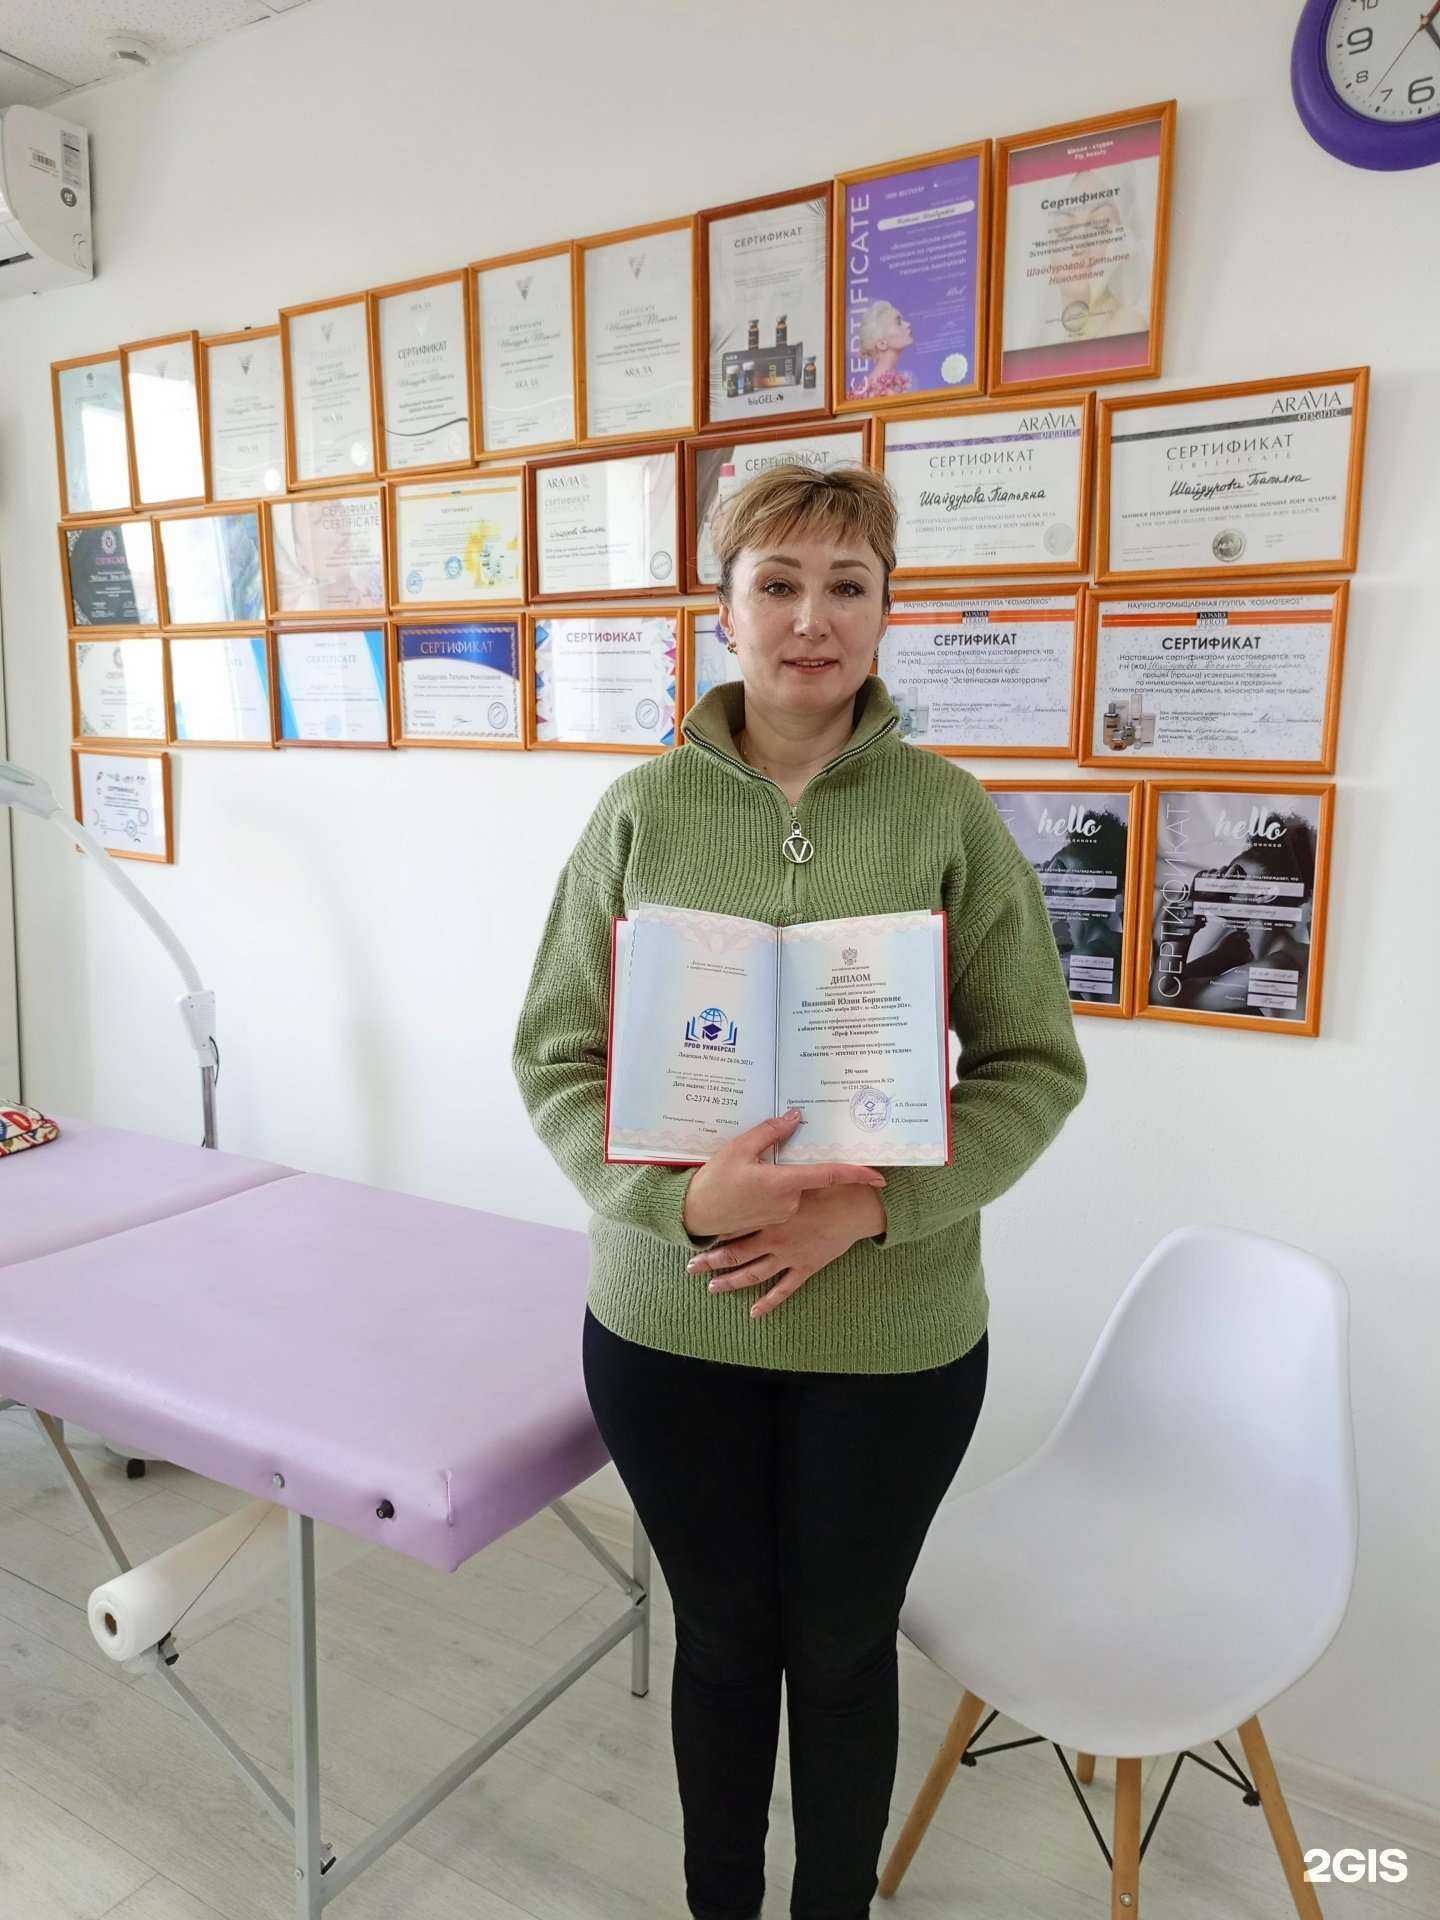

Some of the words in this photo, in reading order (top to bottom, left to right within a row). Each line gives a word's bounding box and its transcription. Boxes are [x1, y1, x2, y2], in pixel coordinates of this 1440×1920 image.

[1347, 27, 1373, 55] 9
[1356, 70, 1369, 84] 8
[1380, 89, 1393, 102] 7
[1407, 76, 1435, 104] 6
[1041, 187, 1120, 210] Сертификат
[733, 226, 803, 249] СЕРТИФИКАТ
[1271, 391, 1342, 414] ARAVIA
[1017, 412, 1076, 432] ARAVIA
[1166, 433, 1293, 460] СЕРТИФИКАТ
[745, 451, 830, 472] СЕРТИФИКАТ
[929, 449, 1035, 468] СЕРТИФИКАТ
[919, 487, 985, 512] Шайдурова
[987, 486, 1046, 502] Татьяна
[420, 640, 494, 654] СЕРТИФИКАТ
[566, 631, 643, 643] СЕРТИФИКАТ
[933, 633, 1018, 647] СЕРТИФИКАТ
[1162, 636, 1262, 650] СЕРТИФИКАТ
[1037, 805, 1102, 837] hello
[1214, 805, 1287, 841] hello
[1157, 802, 1191, 999] СЕРТИФИКАТ
[830, 973, 871, 985] ДИПЛОМ
[702, 1044, 736, 1053] УНИВЕРСАЛ
